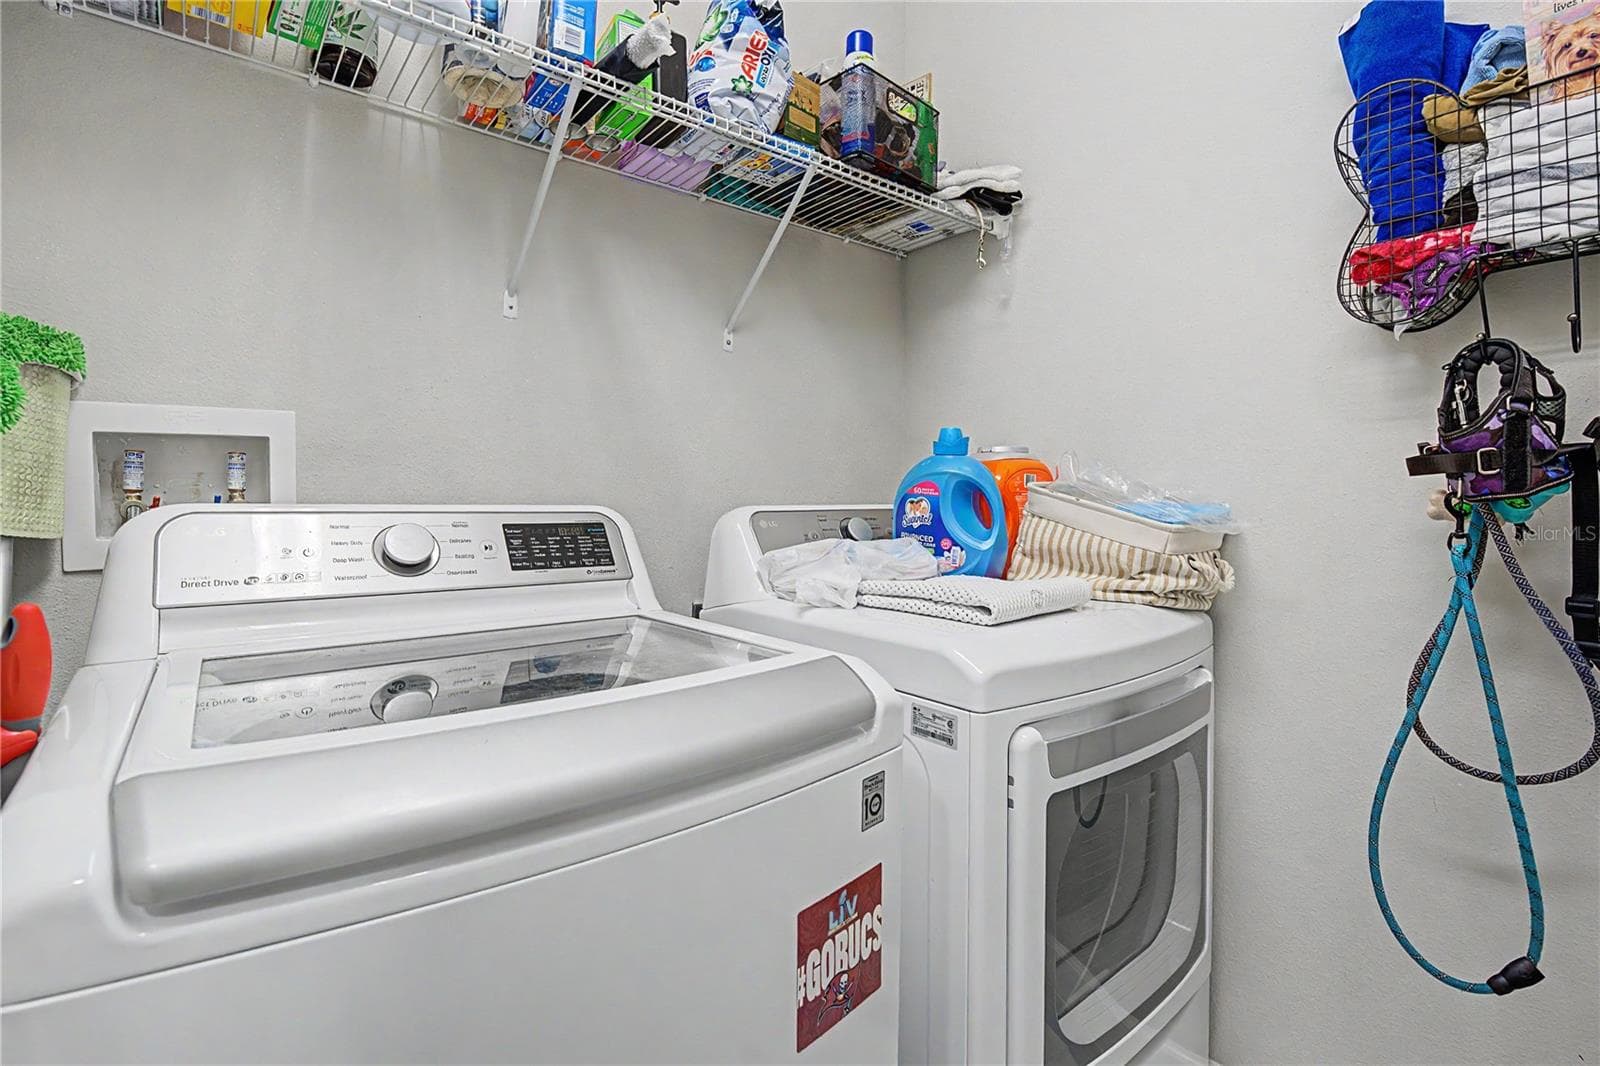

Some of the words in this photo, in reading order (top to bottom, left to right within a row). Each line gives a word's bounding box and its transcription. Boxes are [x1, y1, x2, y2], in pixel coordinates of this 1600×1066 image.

[1553, 0, 1578, 13] lives
[760, 46, 776, 66] OXI
[180, 580, 211, 588] Direct
[213, 579, 239, 587] Drive
[865, 793, 882, 821] 10
[797, 904, 882, 1007] #GOBUCS
